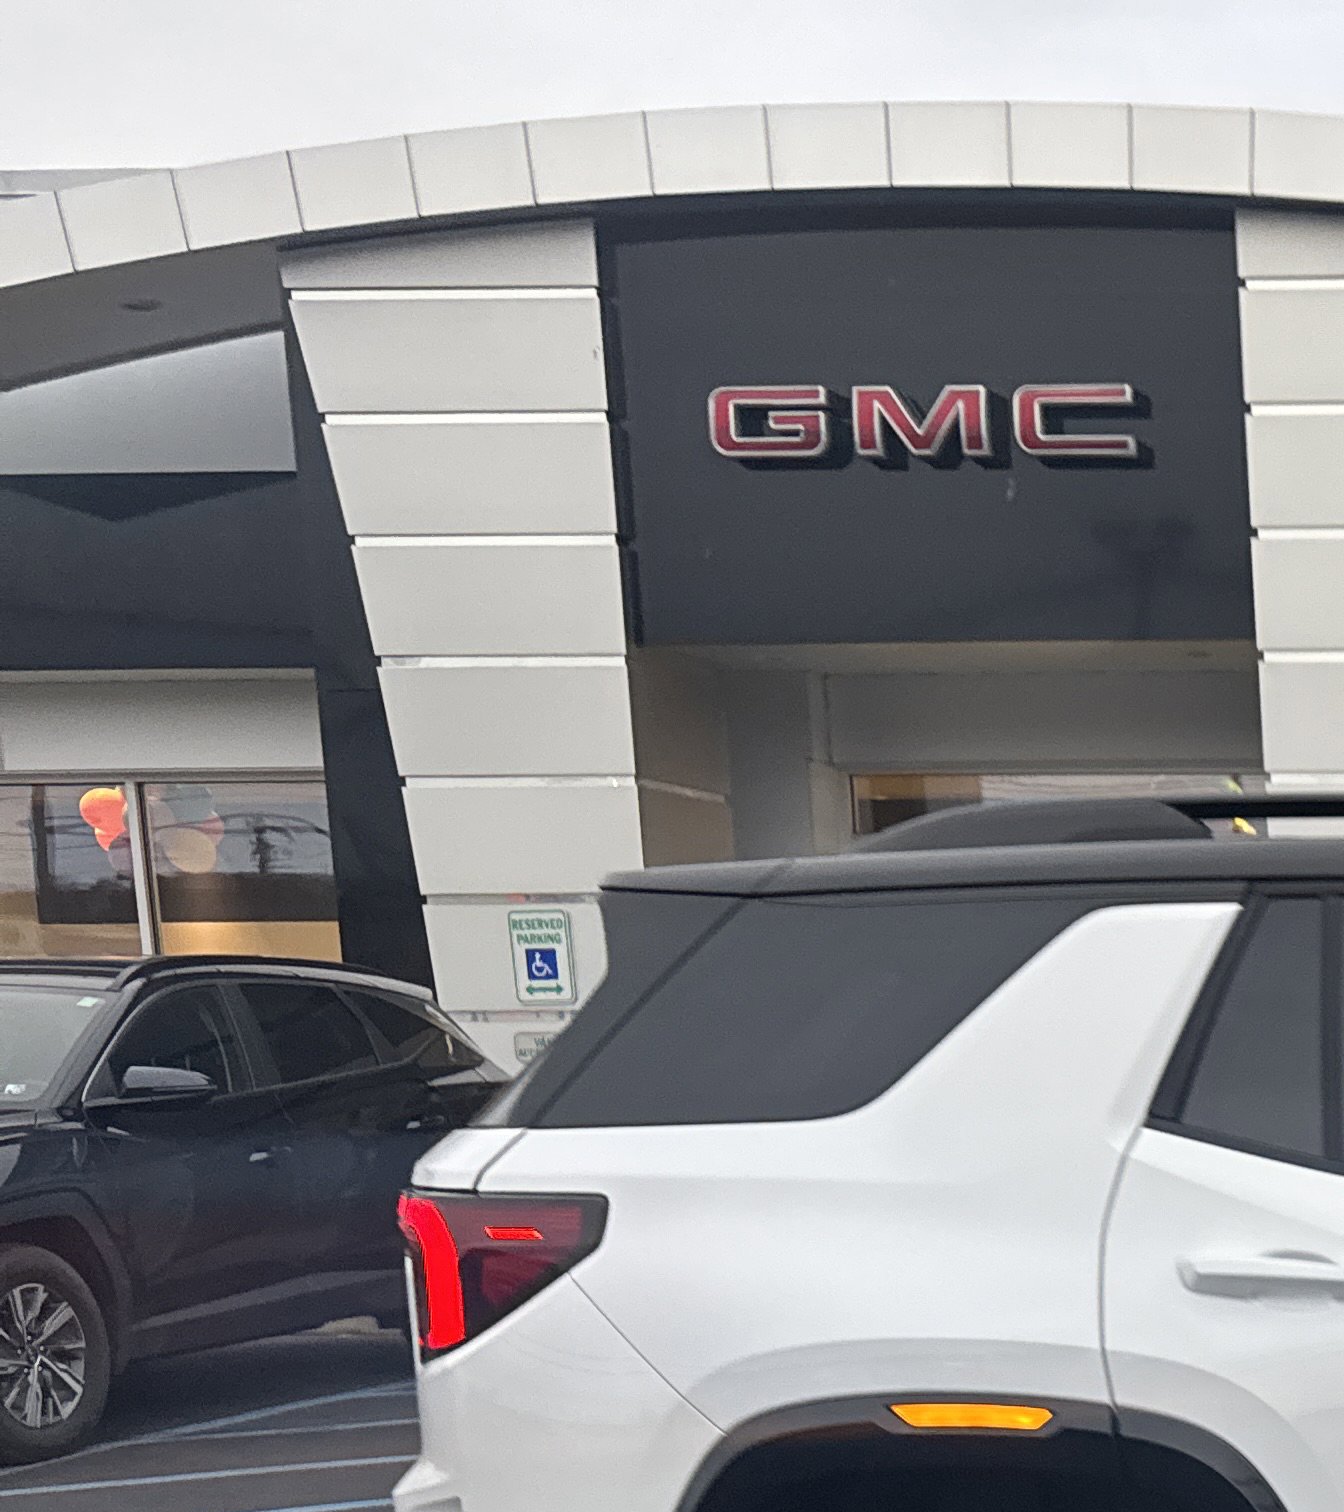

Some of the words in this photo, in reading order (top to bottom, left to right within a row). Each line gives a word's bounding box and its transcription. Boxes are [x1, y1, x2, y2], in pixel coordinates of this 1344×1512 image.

[708, 384, 1137, 457] GMC
[511, 917, 563, 931] RESERVED
[516, 933, 562, 945] PARKING
